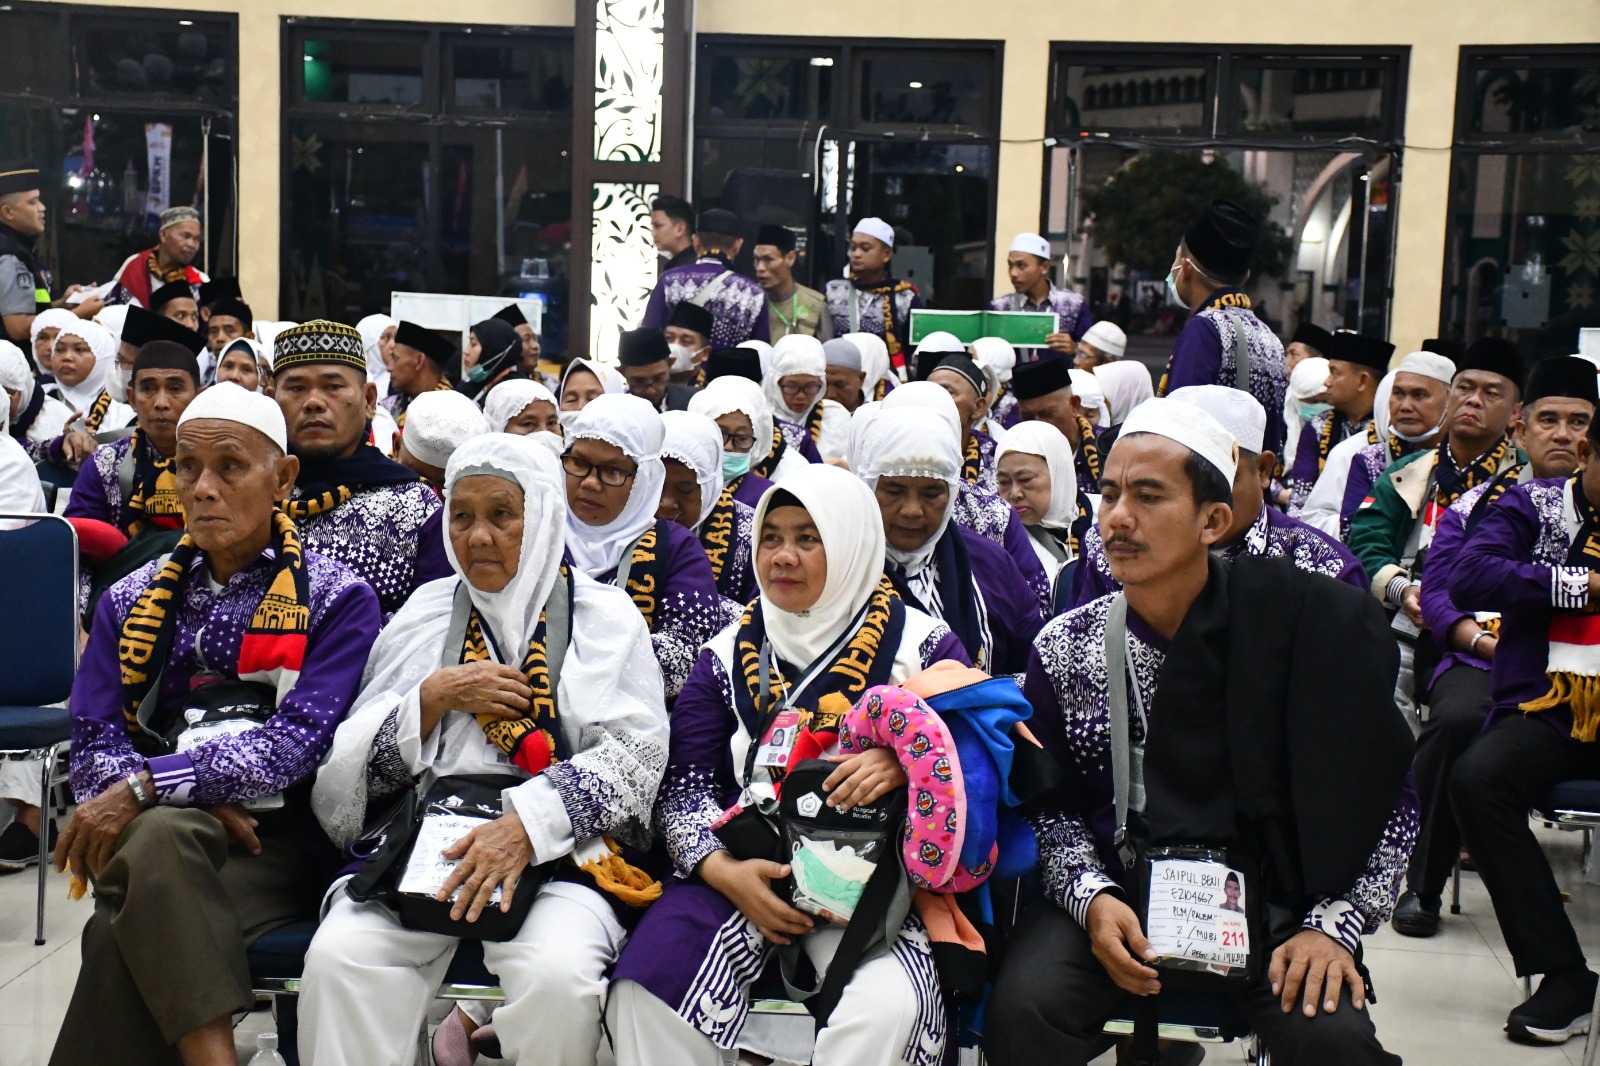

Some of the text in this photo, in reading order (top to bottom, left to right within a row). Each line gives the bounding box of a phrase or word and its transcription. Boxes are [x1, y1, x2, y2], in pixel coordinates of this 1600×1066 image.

[119, 588, 173, 685] MUBA
[1162, 868, 1198, 884] SAIPUL
[1222, 930, 1246, 947] 211
